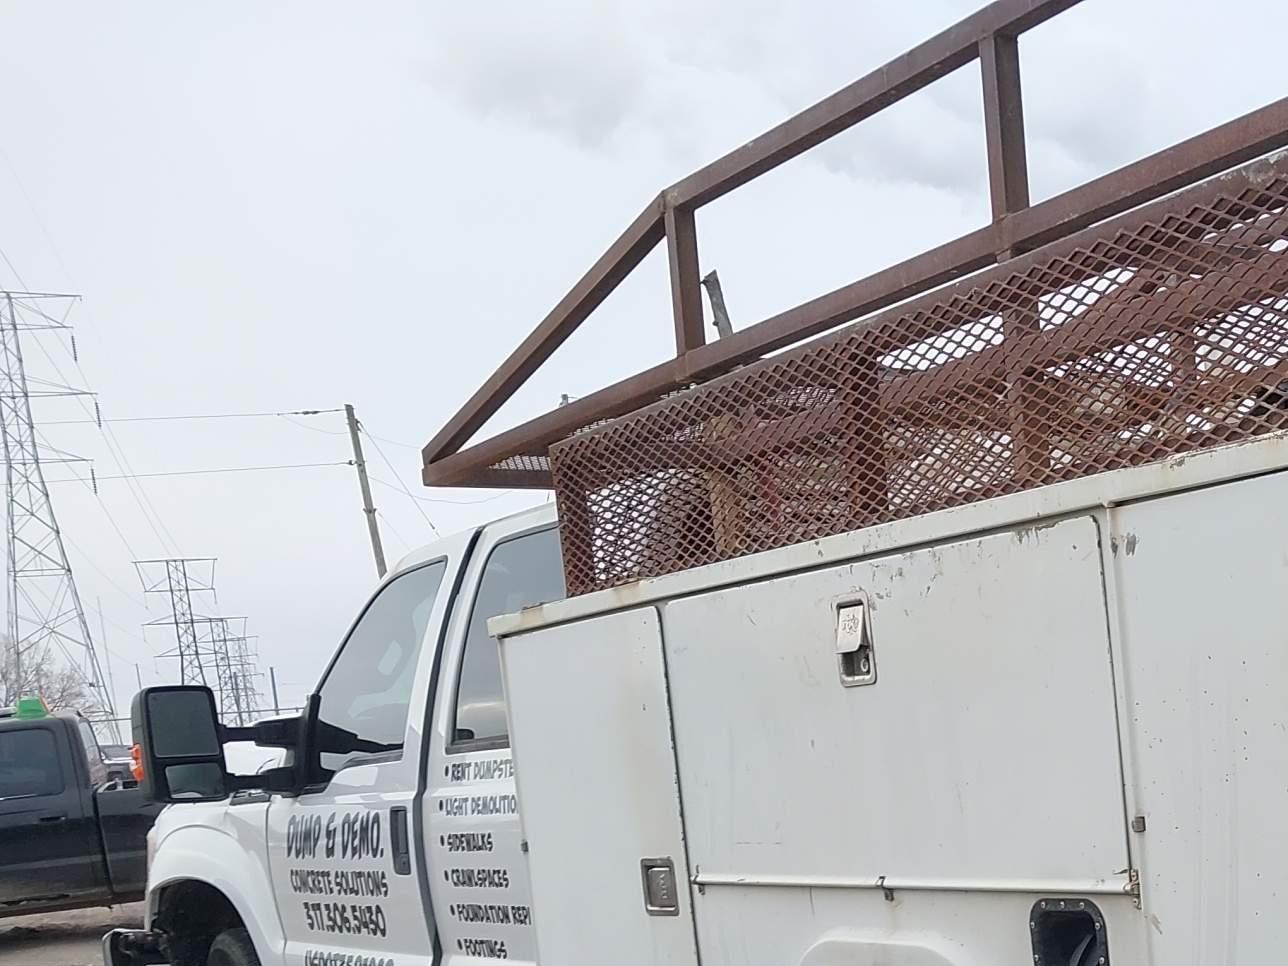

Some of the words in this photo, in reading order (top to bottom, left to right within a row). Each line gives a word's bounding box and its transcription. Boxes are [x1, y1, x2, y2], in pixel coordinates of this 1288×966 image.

[451, 762, 472, 782] RENT
[445, 797, 469, 817] LIGHT
[287, 813, 322, 860] DUMP
[325, 812, 337, 859] &
[342, 811, 384, 861] DEMO.
[447, 832, 493, 853] SIDEWALKS
[290, 869, 333, 895] CONCRETE
[335, 870, 389, 897] SOLUTIONS
[451, 868, 509, 889] CRAWLSPACES
[457, 904, 511, 925] FOUNDATION
[511, 905, 531, 926] REP
[463, 939, 508, 960] FOOTINGS
